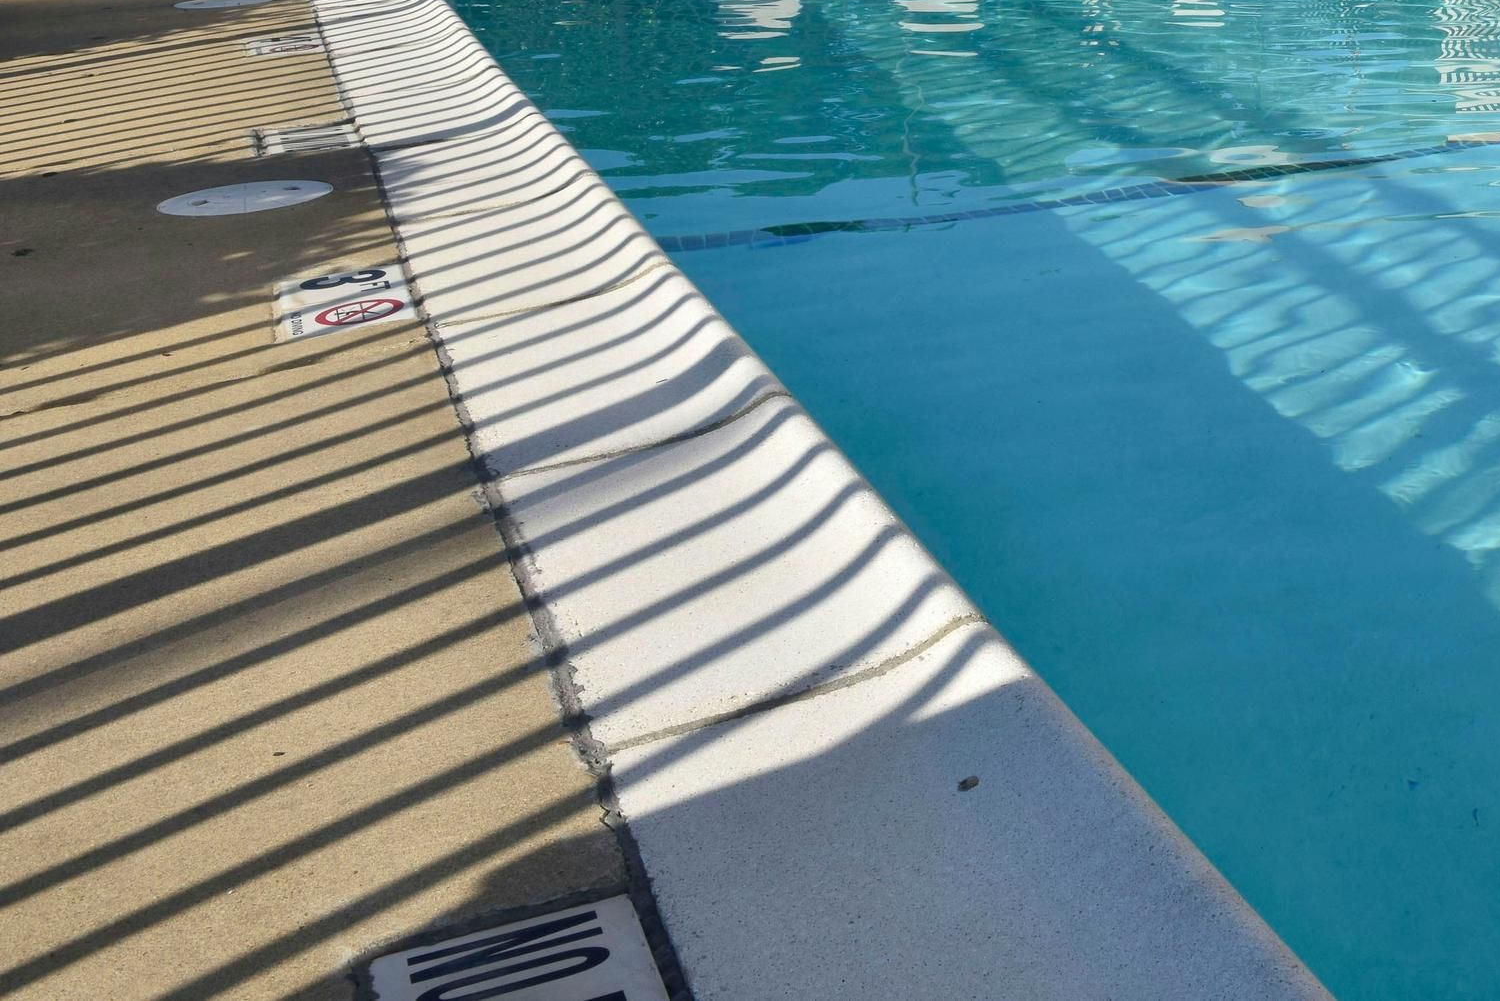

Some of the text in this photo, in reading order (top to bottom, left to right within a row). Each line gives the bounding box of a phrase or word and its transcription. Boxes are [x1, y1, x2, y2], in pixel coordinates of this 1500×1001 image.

[300, 269, 392, 293] 3 FT
[406, 910, 611, 1001] NO
